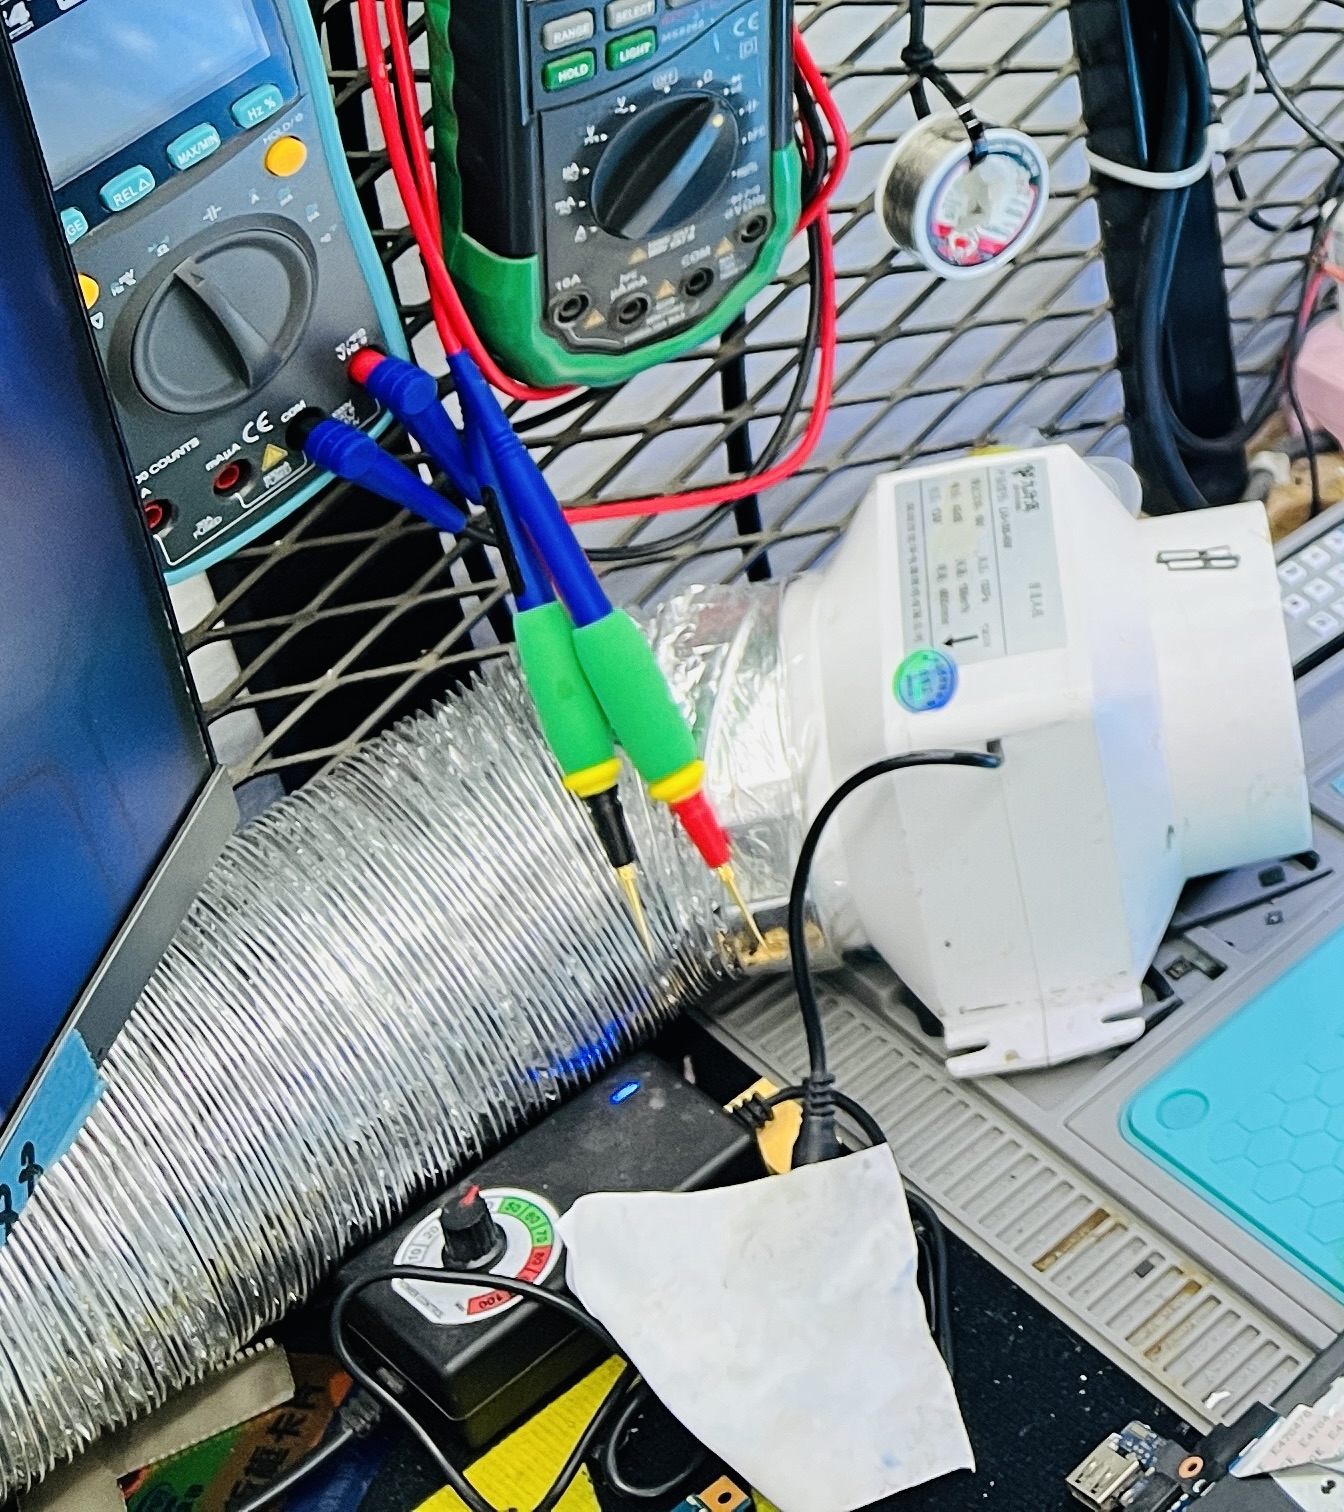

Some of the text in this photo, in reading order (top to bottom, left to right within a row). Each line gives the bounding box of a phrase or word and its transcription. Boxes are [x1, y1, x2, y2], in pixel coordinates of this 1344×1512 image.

[553, 23, 590, 44] RANGE
[615, 1, 654, 23] SELECT
[558, 41, 651, 83] HOLD LIGHT
[112, 185, 139, 207] REL
[176, 133, 220, 165] MAX/MIN
[247, 105, 264, 121] Hz
[242, 410, 274, 444] CE
[149, 437, 201, 475] COUNTS
[408, 1248, 423, 1261] 10
